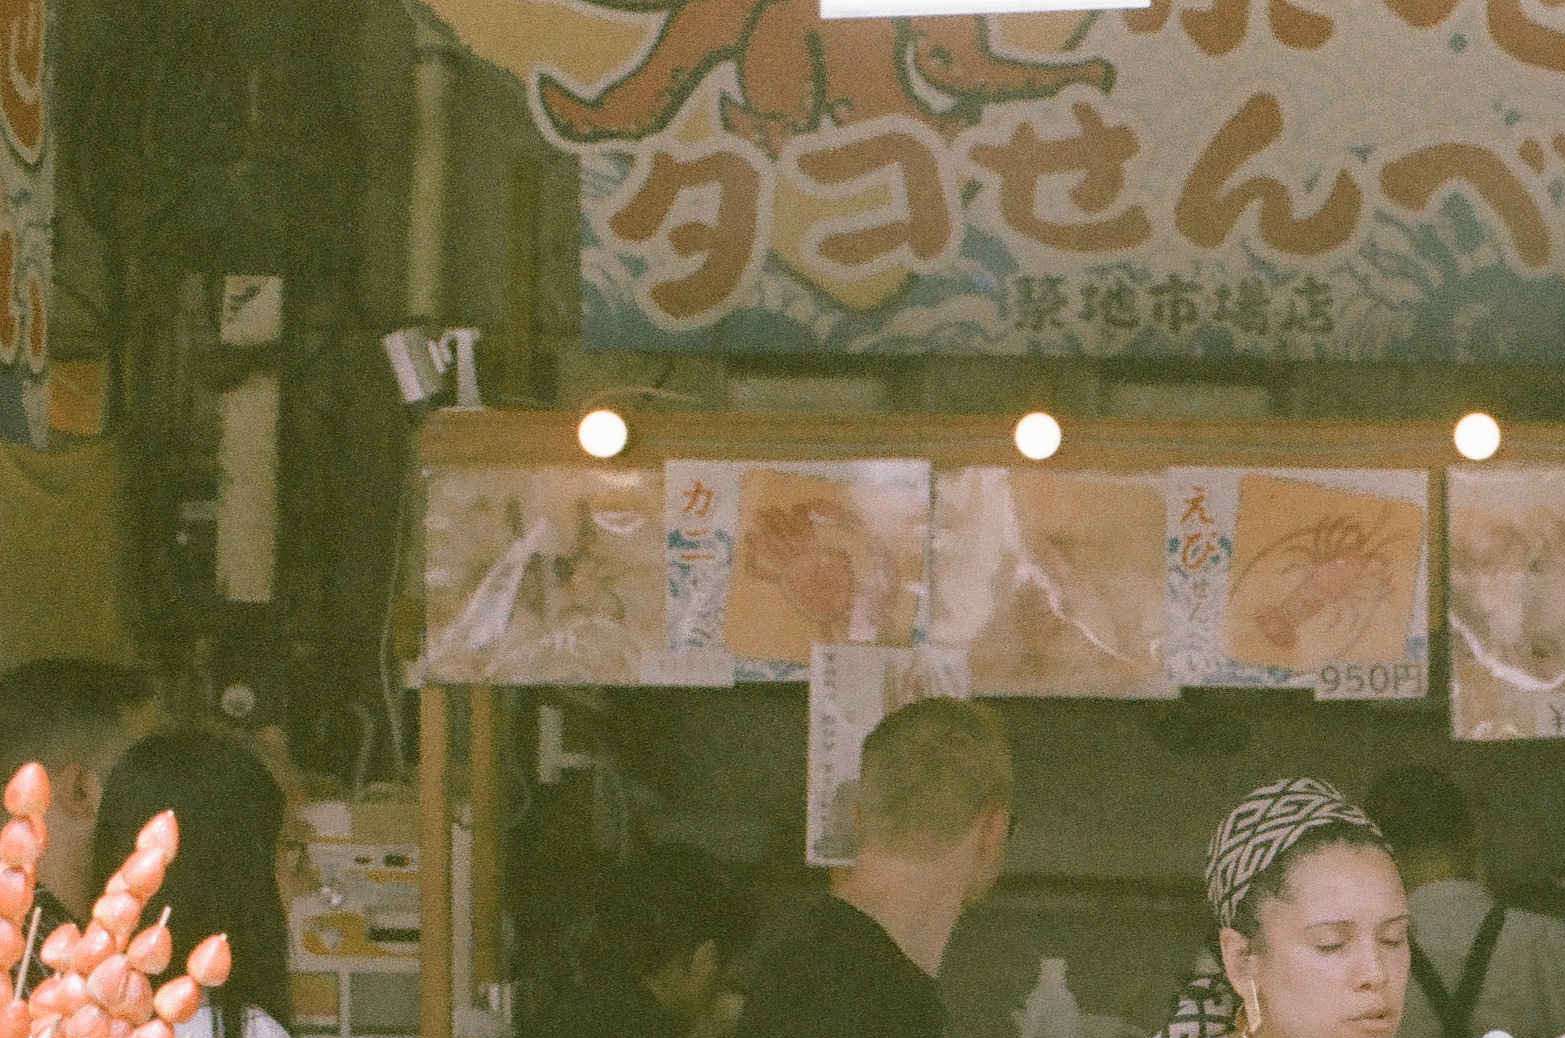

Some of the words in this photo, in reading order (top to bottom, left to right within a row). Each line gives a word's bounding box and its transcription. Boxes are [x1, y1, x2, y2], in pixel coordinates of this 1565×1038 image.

[1014, 274, 1336, 336] 築地市場店
[1319, 664, 1422, 694] 950円
